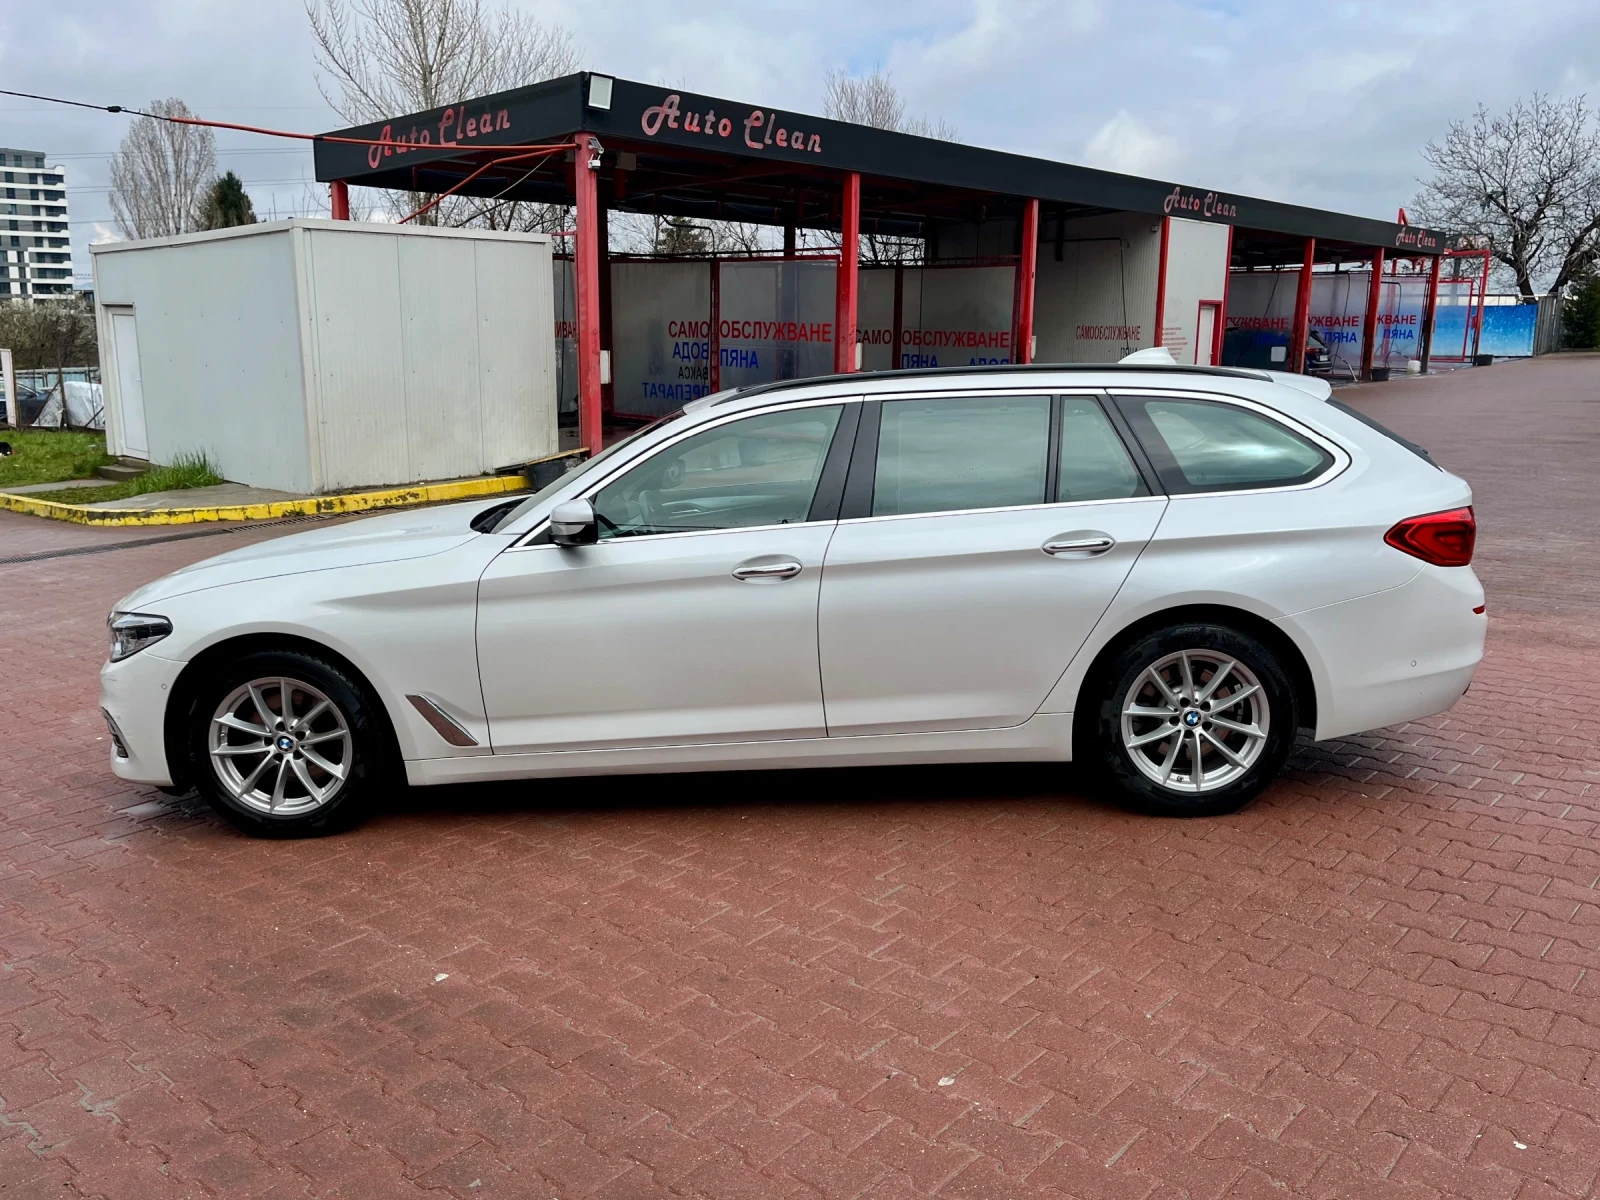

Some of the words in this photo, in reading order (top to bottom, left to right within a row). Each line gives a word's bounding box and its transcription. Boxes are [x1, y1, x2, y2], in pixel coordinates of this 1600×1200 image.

[641, 94, 732, 136] Auto
[743, 110, 822, 152] Clean
[367, 124, 430, 169] Auto
[437, 105, 511, 146] Clean
[1164, 186, 1200, 213] Auto
[1204, 192, 1237, 217] Clean
[1395, 226, 1417, 247] Auto
[1417, 229, 1436, 248] Clean
[719, 320, 832, 342] ОБСЛУЖВАНЕ
[901, 330, 1010, 348] ОБСЛУЖВАНЕ
[719, 348, 759, 369] ПЯНА
